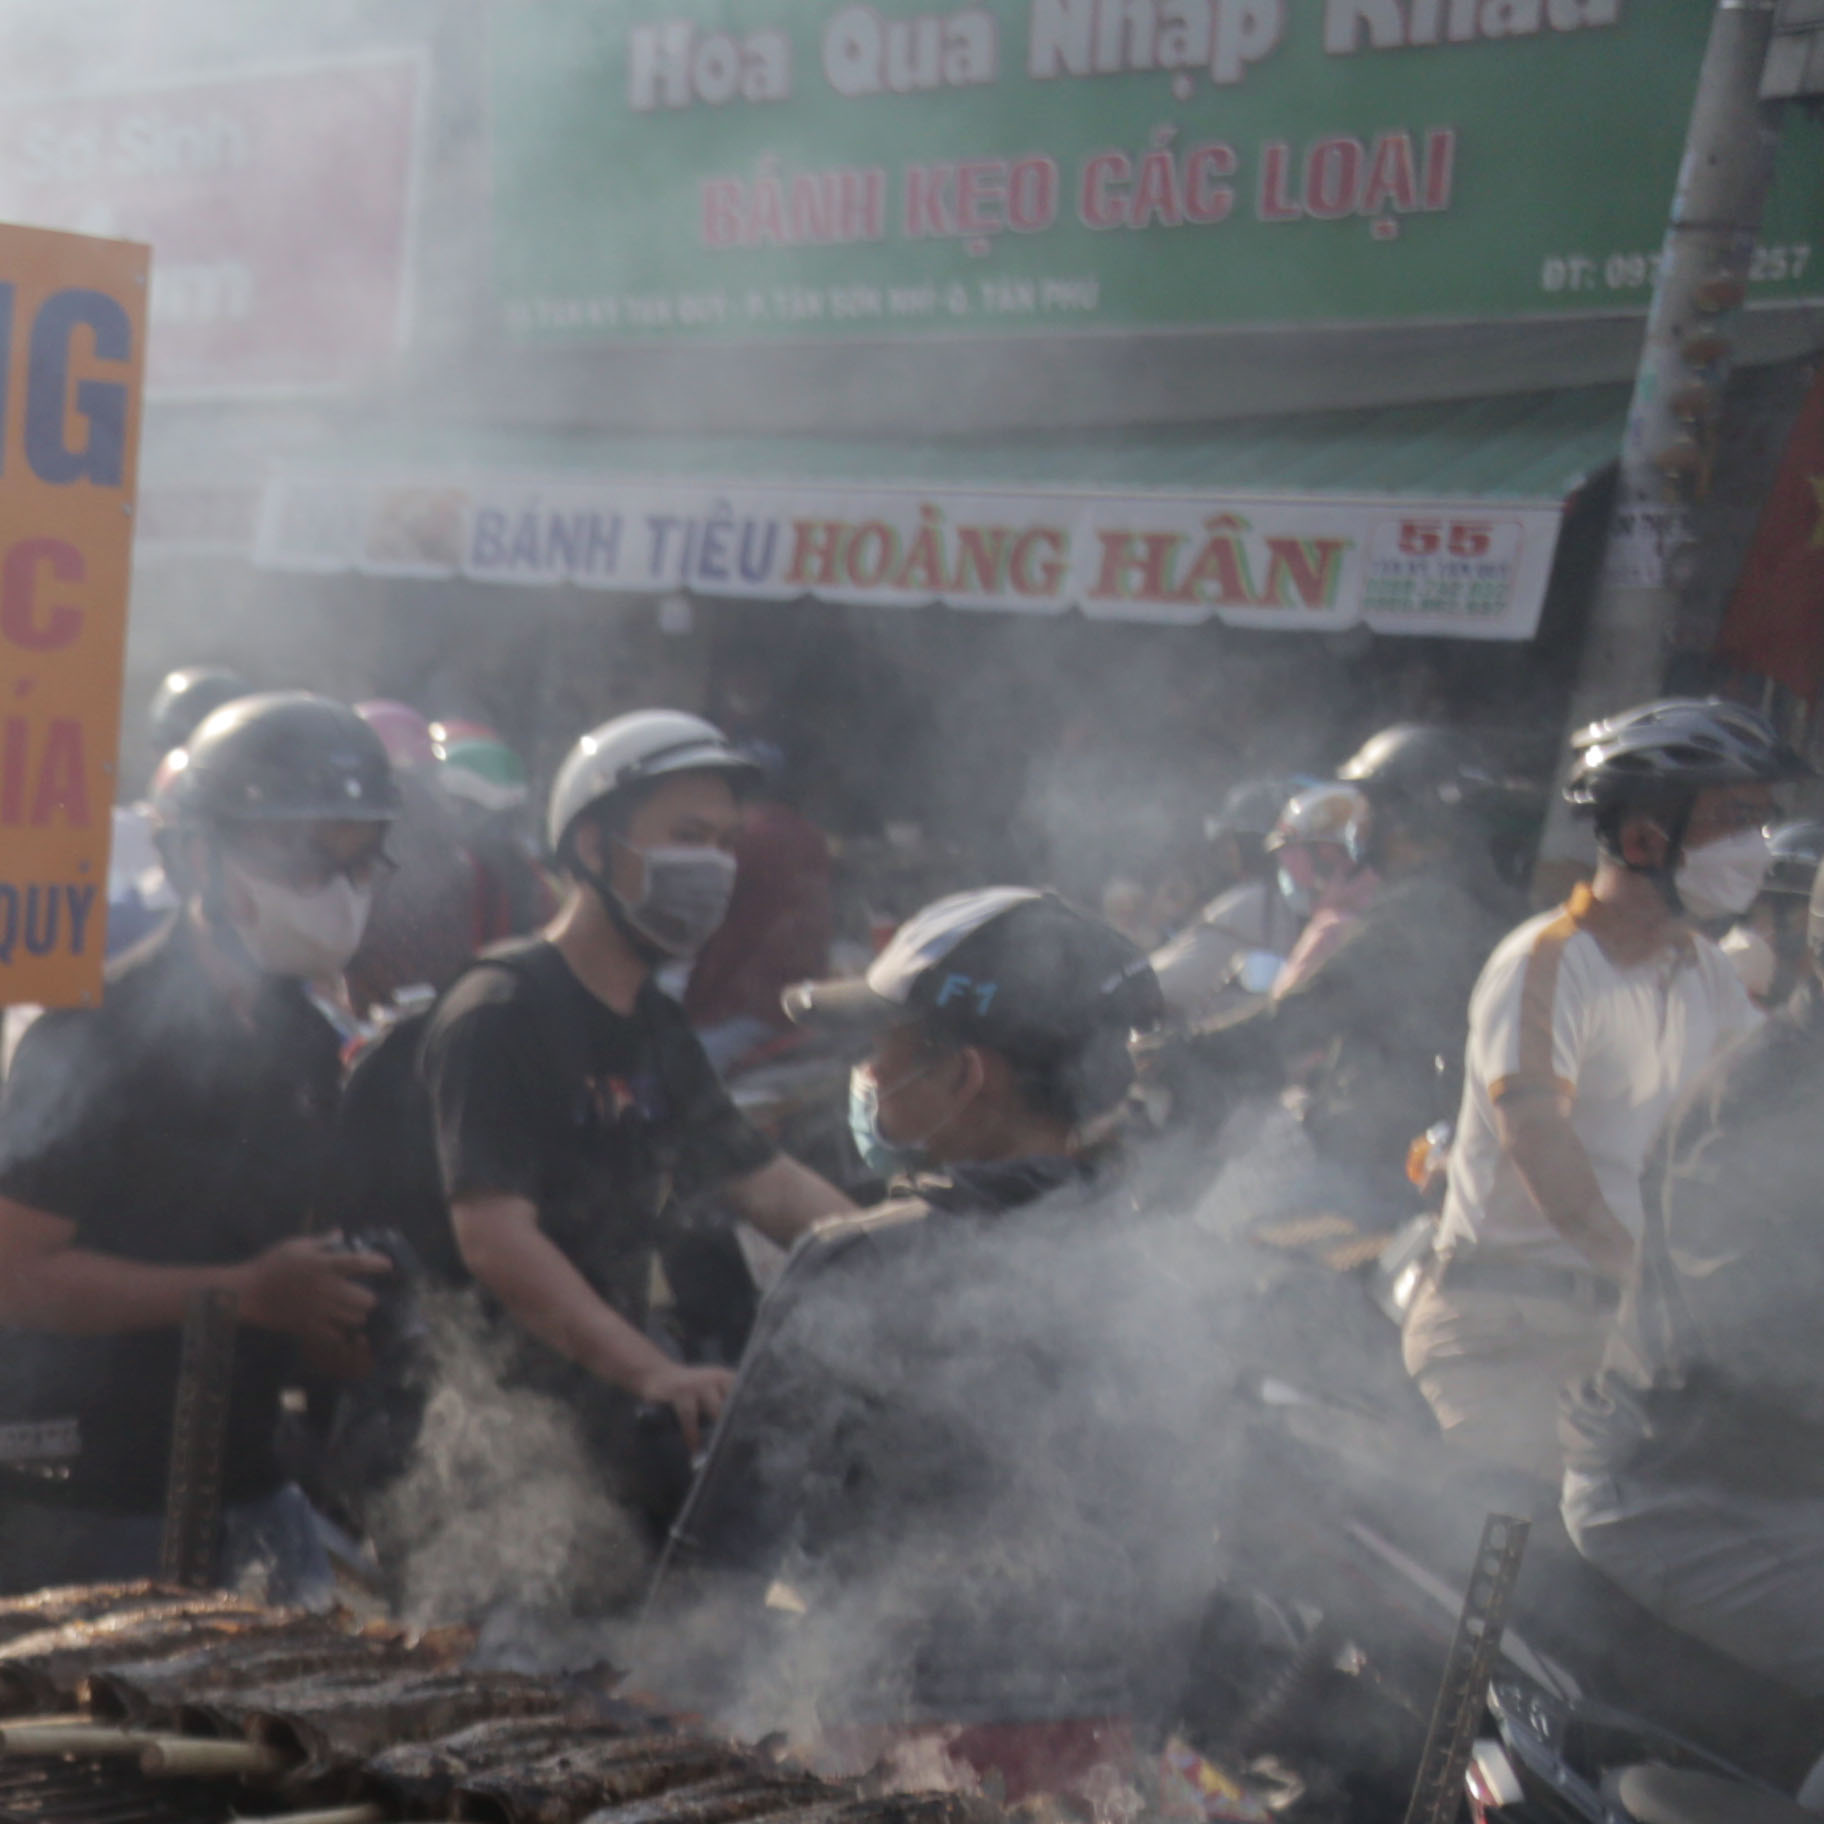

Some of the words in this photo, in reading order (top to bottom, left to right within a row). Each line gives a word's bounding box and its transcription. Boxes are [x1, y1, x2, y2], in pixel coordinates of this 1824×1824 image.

[628, 20, 792, 112] Hoa
[699, 149, 887, 249] BÁNH
[902, 153, 1058, 257] KẸO
[1079, 123, 1237, 232] CÁC
[1256, 127, 1456, 239] LOẠI
[470, 494, 622, 576] BÁNH
[642, 495, 780, 584] TIÊU
[783, 500, 1072, 598] HOÀNG
[1085, 509, 1357, 612] HÂN
[1396, 518, 1493, 558] 55
[935, 970, 1000, 1018] F1
